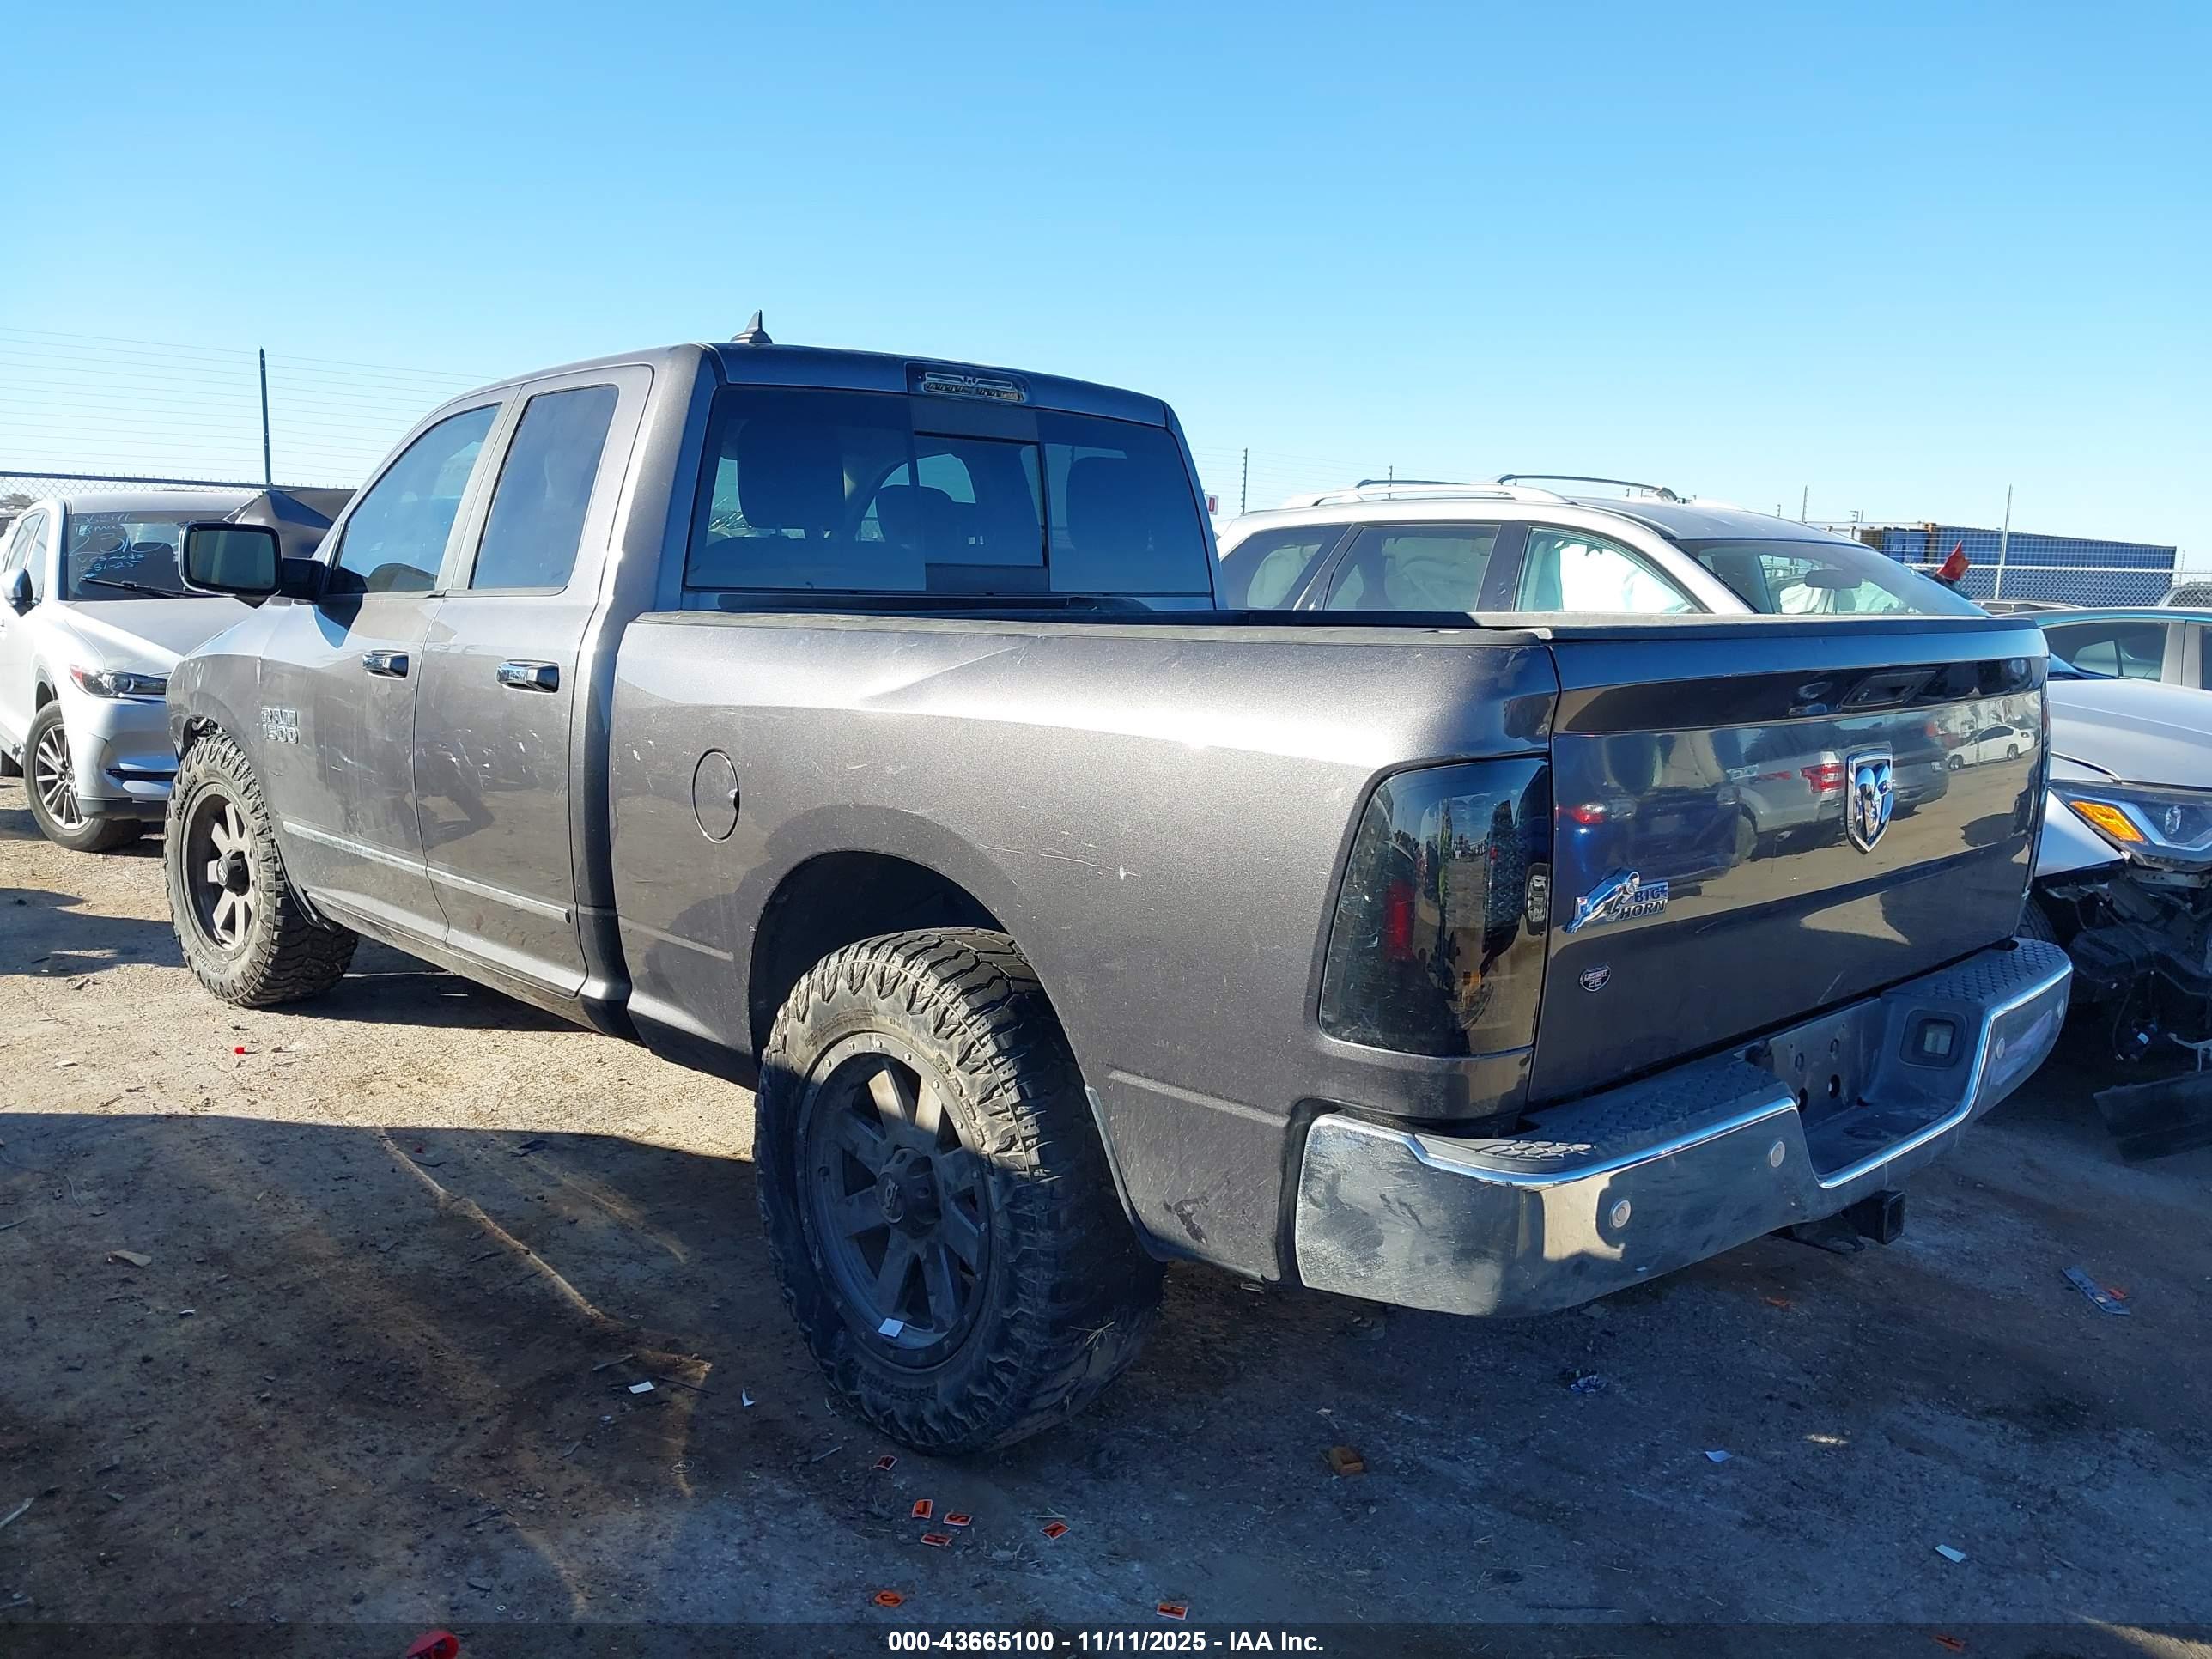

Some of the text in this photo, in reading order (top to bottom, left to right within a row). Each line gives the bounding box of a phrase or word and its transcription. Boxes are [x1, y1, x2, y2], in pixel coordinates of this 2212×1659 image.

[261, 707, 298, 726] RAM
[262, 723, 299, 744] 1500
[1634, 887, 1662, 903] BIG
[1619, 900, 1666, 920] HORN
